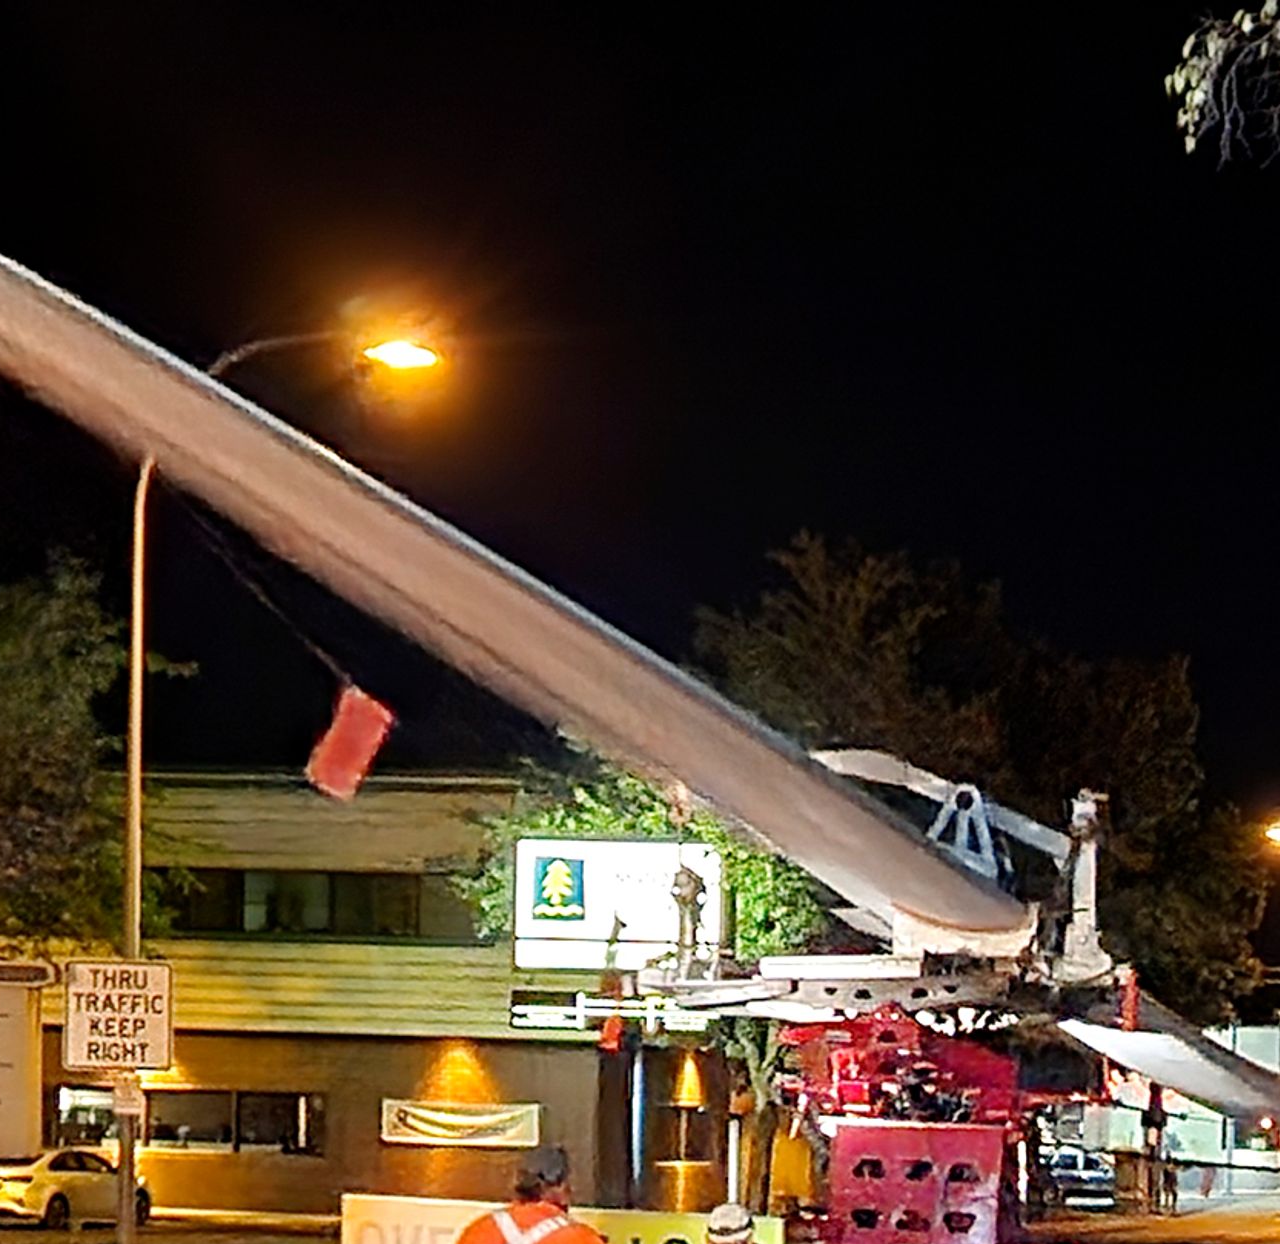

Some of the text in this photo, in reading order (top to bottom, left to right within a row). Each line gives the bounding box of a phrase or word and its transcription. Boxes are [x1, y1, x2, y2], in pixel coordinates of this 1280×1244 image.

[89, 969, 148, 989] THRU
[74, 992, 164, 1014] TRAFFIC
[89, 1017, 146, 1037] KEEP
[87, 1042, 149, 1062] RIGHT
